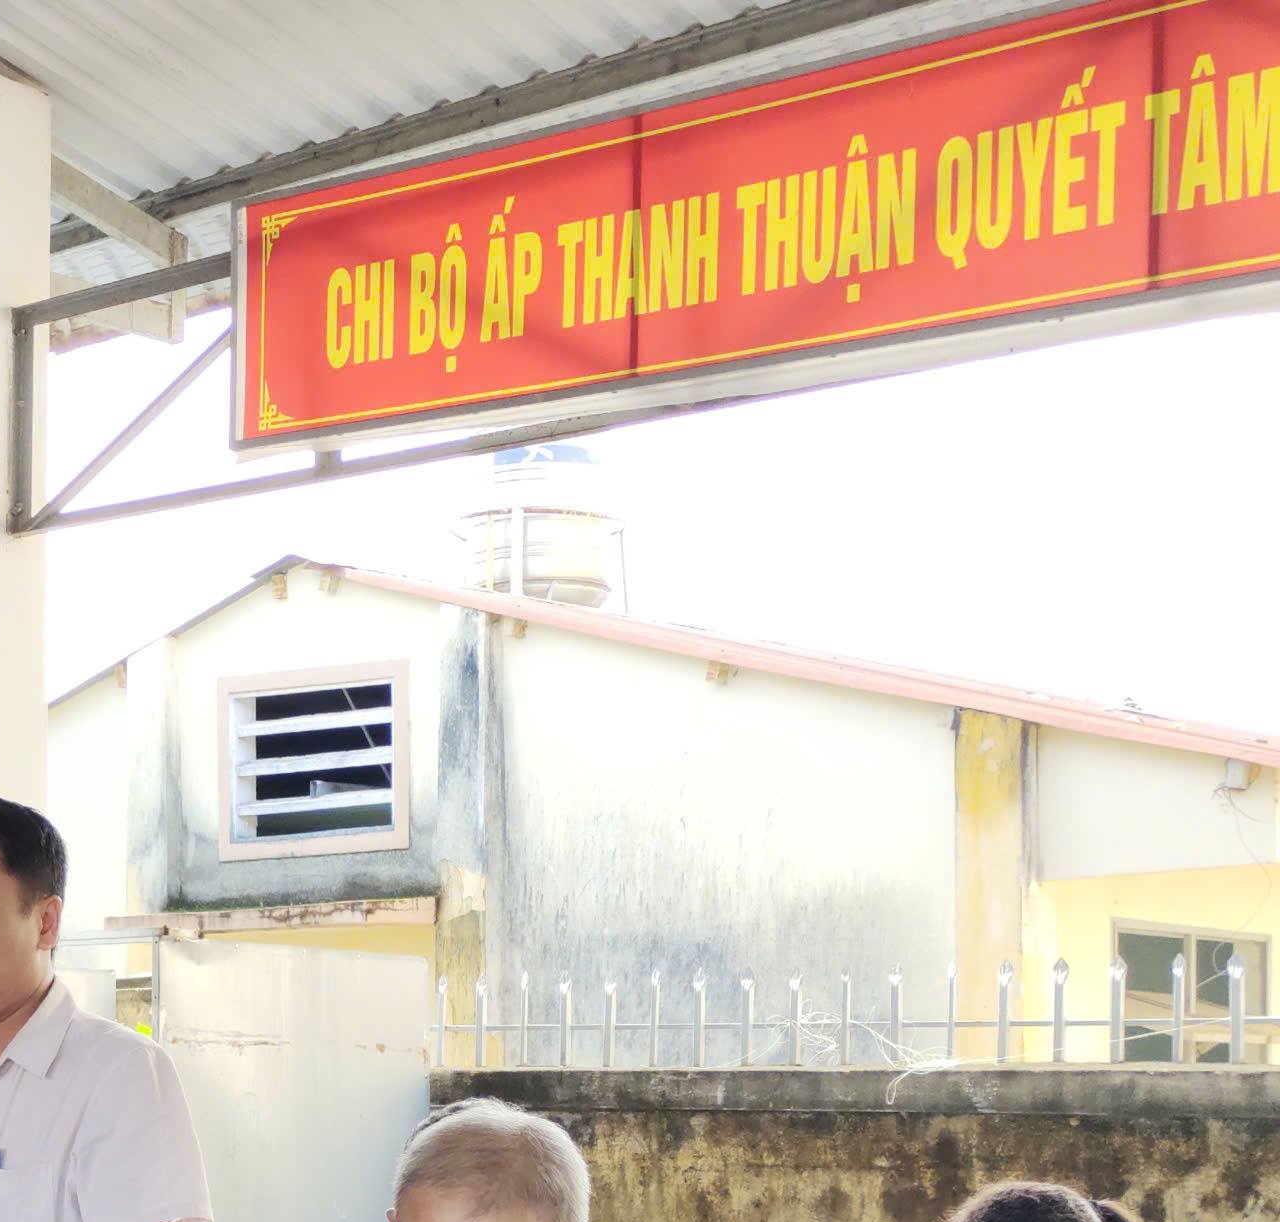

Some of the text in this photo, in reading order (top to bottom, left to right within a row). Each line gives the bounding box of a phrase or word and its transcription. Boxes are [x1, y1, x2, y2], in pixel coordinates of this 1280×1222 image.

[326, 53, 1280, 374] CHI BỘ ẤP THANH THUẬN QUYẾT TÂM
